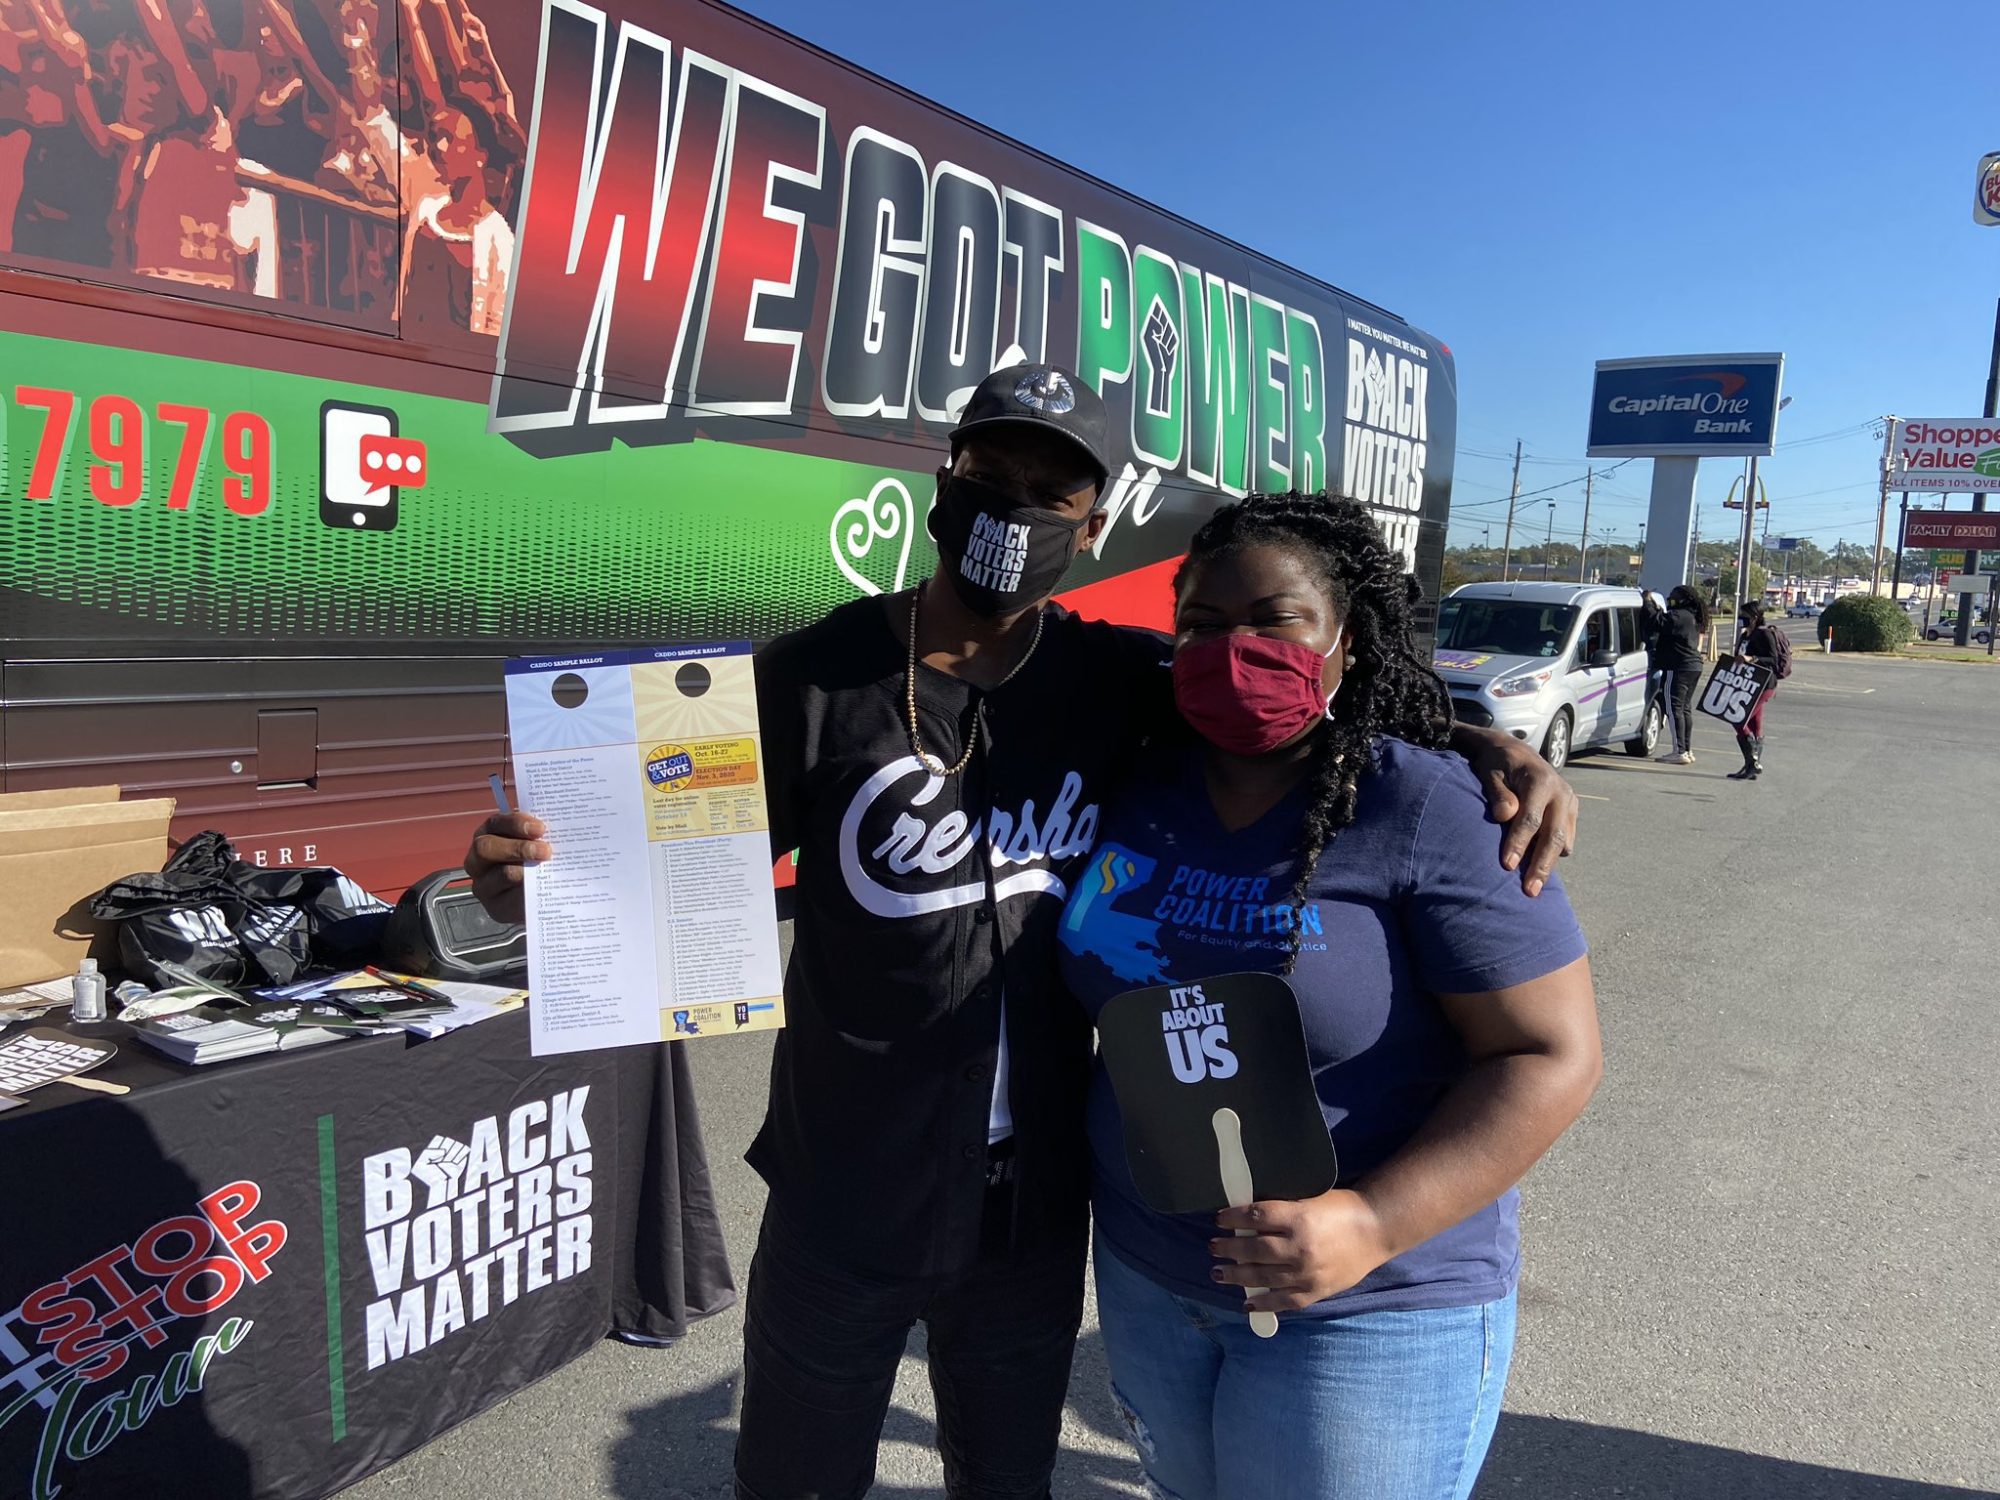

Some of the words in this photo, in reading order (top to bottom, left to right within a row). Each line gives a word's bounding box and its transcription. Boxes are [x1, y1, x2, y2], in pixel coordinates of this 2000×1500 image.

[484, 0, 827, 432] WE
[820, 124, 1064, 422] GOT
[1075, 217, 1327, 498] POWER
[1371, 326, 1383, 341] YOU
[1401, 339, 1410, 352] WE
[1346, 337, 1429, 441] BACK
[1693, 418, 1753, 434] Bank
[1342, 422, 1427, 512] VOTERS
[1902, 448, 1976, 468] Value
[1910, 479, 1945, 487] ITEMS
[1949, 480, 1970, 488] 10%
[973, 511, 1031, 550] BACK
[1909, 524, 1952, 536] FAMILY
[967, 533, 1027, 572] VOTERS
[960, 554, 1022, 592] MATTER
[1714, 669, 1760, 694] ABOUT
[1703, 681, 1752, 723] US
[648, 760, 668, 772] GET
[669, 755, 688, 767] OUT
[1168, 865, 1270, 901] POWER
[1153, 894, 1324, 937] COALITION
[1177, 929, 1197, 941] For
[1200, 934, 1241, 948] Equity
[1244, 940, 1274, 949] and
[1277, 941, 1327, 951] Jutice
[1169, 985, 1206, 1009] IT'S
[694, 1013, 721, 1021] COALITION
[1162, 1003, 1224, 1031] ABOUT
[1164, 1024, 1238, 1084] US
[363, 1085, 592, 1231] BACK
[365, 1151, 593, 1297] VOTERS
[20, 1180, 261, 1345] STOP
[53, 1220, 288, 1383] STOP
[366, 1214, 592, 1371] MATTER
[0, 1315, 254, 1500] Tour
